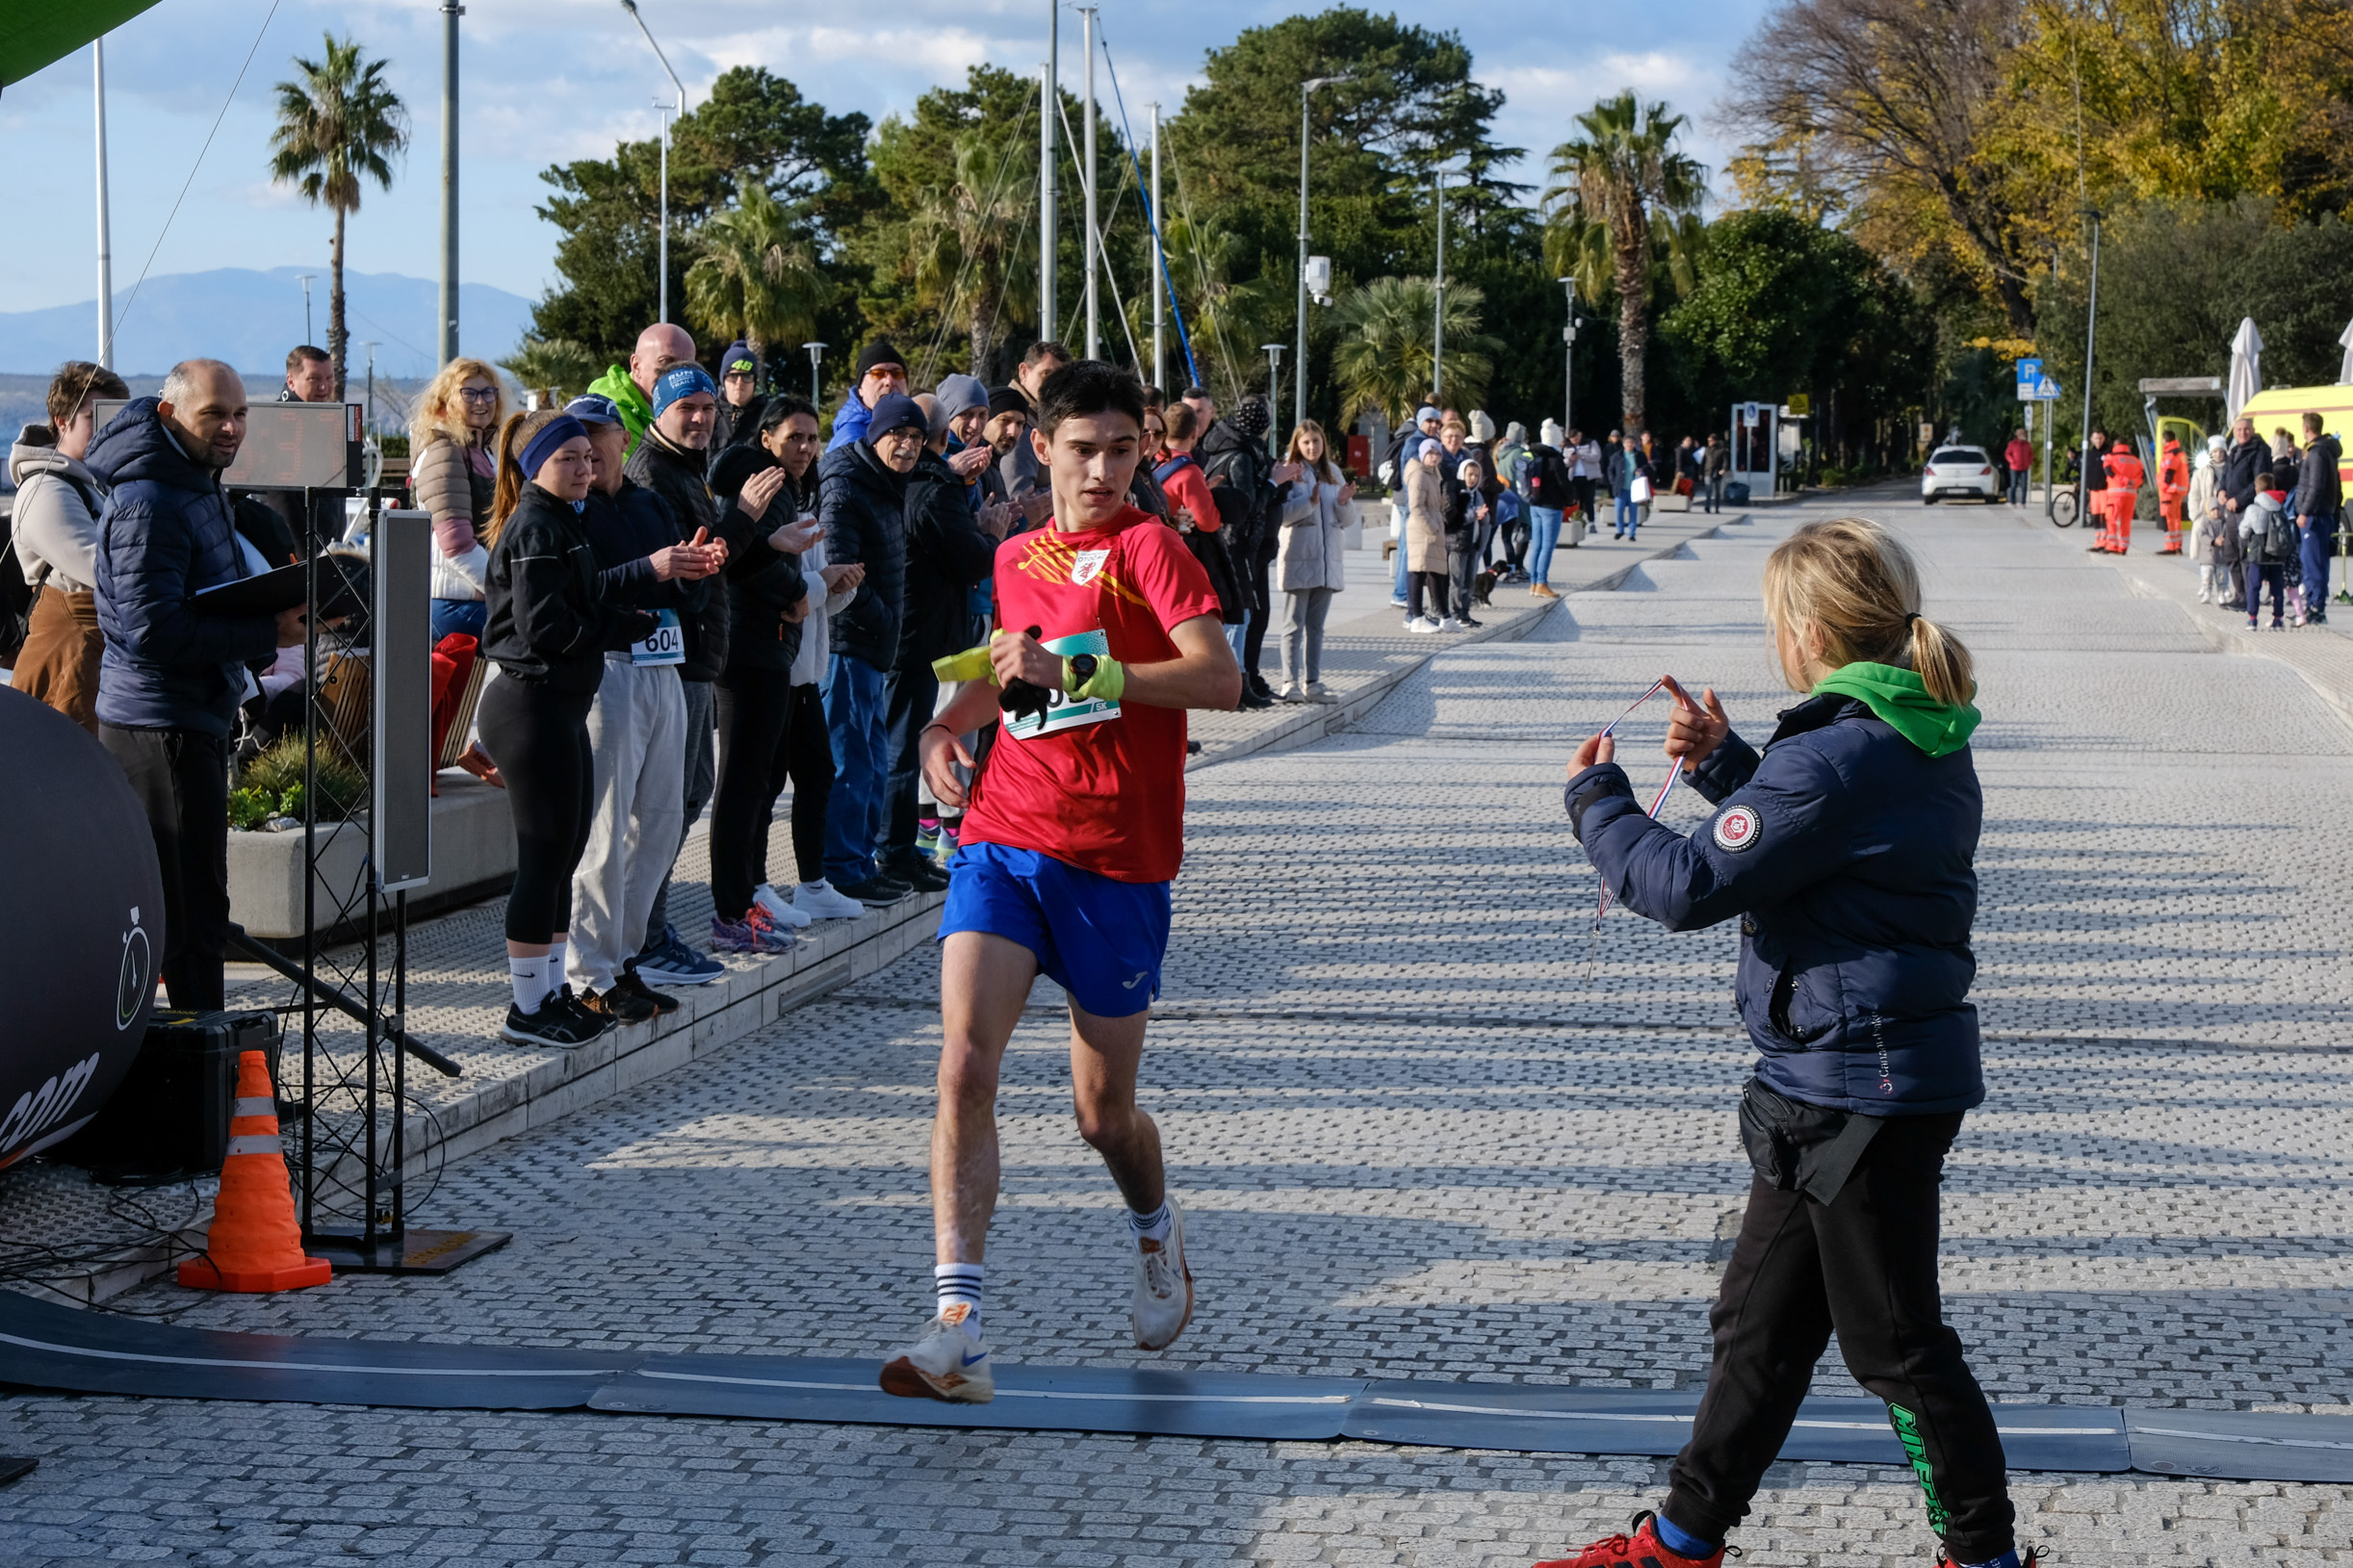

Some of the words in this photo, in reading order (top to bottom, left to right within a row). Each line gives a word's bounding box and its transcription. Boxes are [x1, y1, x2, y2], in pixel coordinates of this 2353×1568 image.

[668, 370, 694, 381] RUN
[2024, 363, 2036, 379] P
[645, 628, 679, 653] 604
[1096, 702, 1107, 711] 5K
